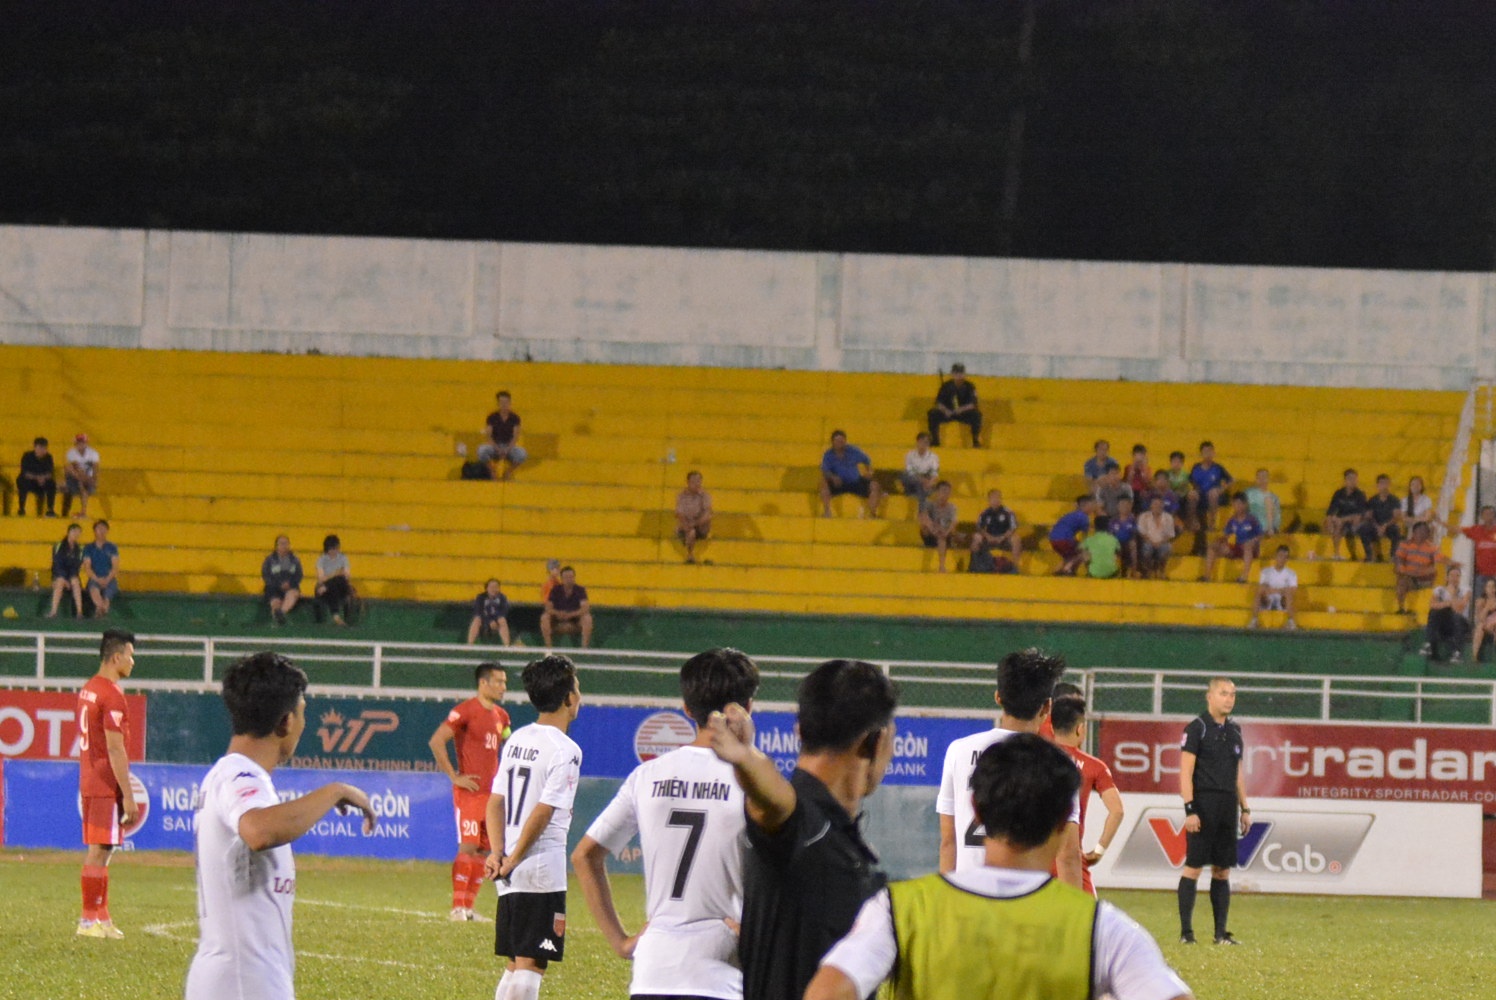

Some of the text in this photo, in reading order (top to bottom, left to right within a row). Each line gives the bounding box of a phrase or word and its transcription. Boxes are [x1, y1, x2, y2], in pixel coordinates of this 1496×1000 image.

[485, 732, 498, 750] 20
[162, 783, 206, 812] NGÂ
[507, 764, 532, 826] 17
[463, 820, 479, 836] 20
[665, 808, 709, 901] 7
[1262, 842, 1326, 874] Cab
